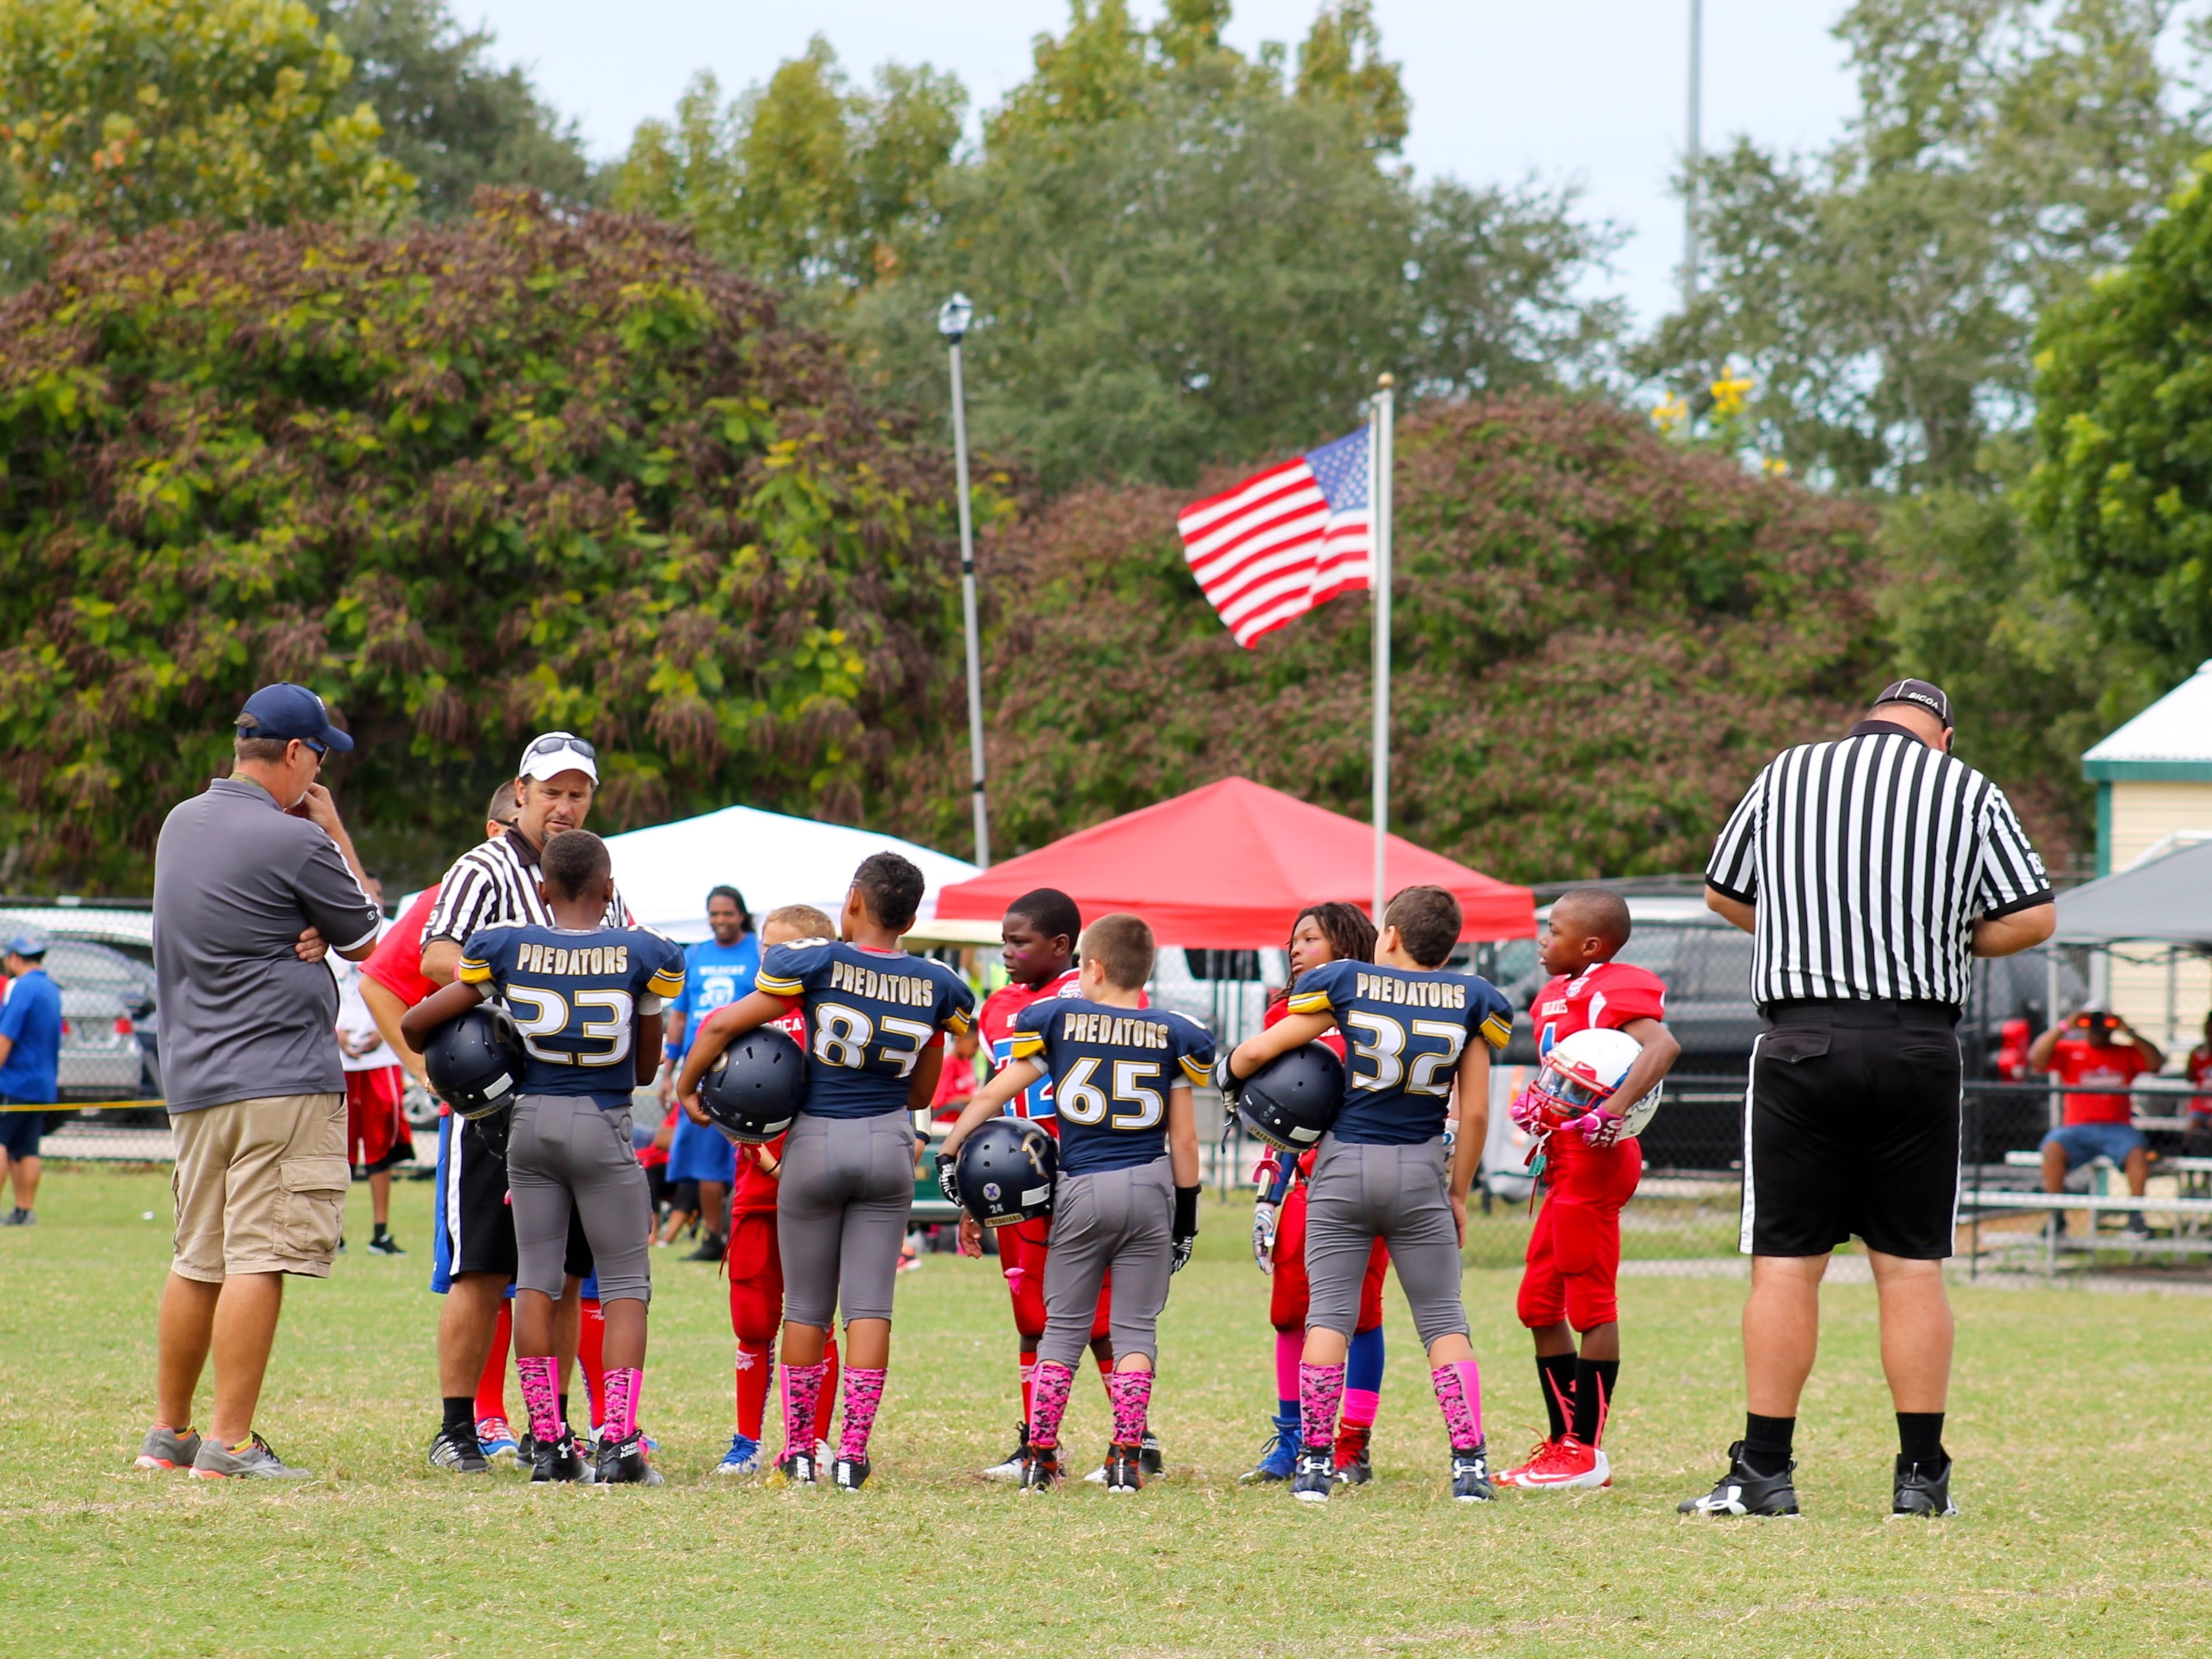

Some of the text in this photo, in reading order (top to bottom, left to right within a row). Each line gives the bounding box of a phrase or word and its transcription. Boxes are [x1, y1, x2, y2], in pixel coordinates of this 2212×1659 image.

[516, 943, 629, 976] PREDATORS
[830, 961, 933, 1007] PREDATORS
[1356, 972, 1466, 1009] PREDATORS
[506, 984, 634, 1066] 23
[813, 1001, 934, 1078] 83
[1063, 1013, 1169, 1049] PREDATORS
[1347, 1009, 1468, 1097] 32
[1056, 1057, 1164, 1129] 65
[989, 1203, 1004, 1214] 24
[838, 1461, 851, 1485] NIKE
